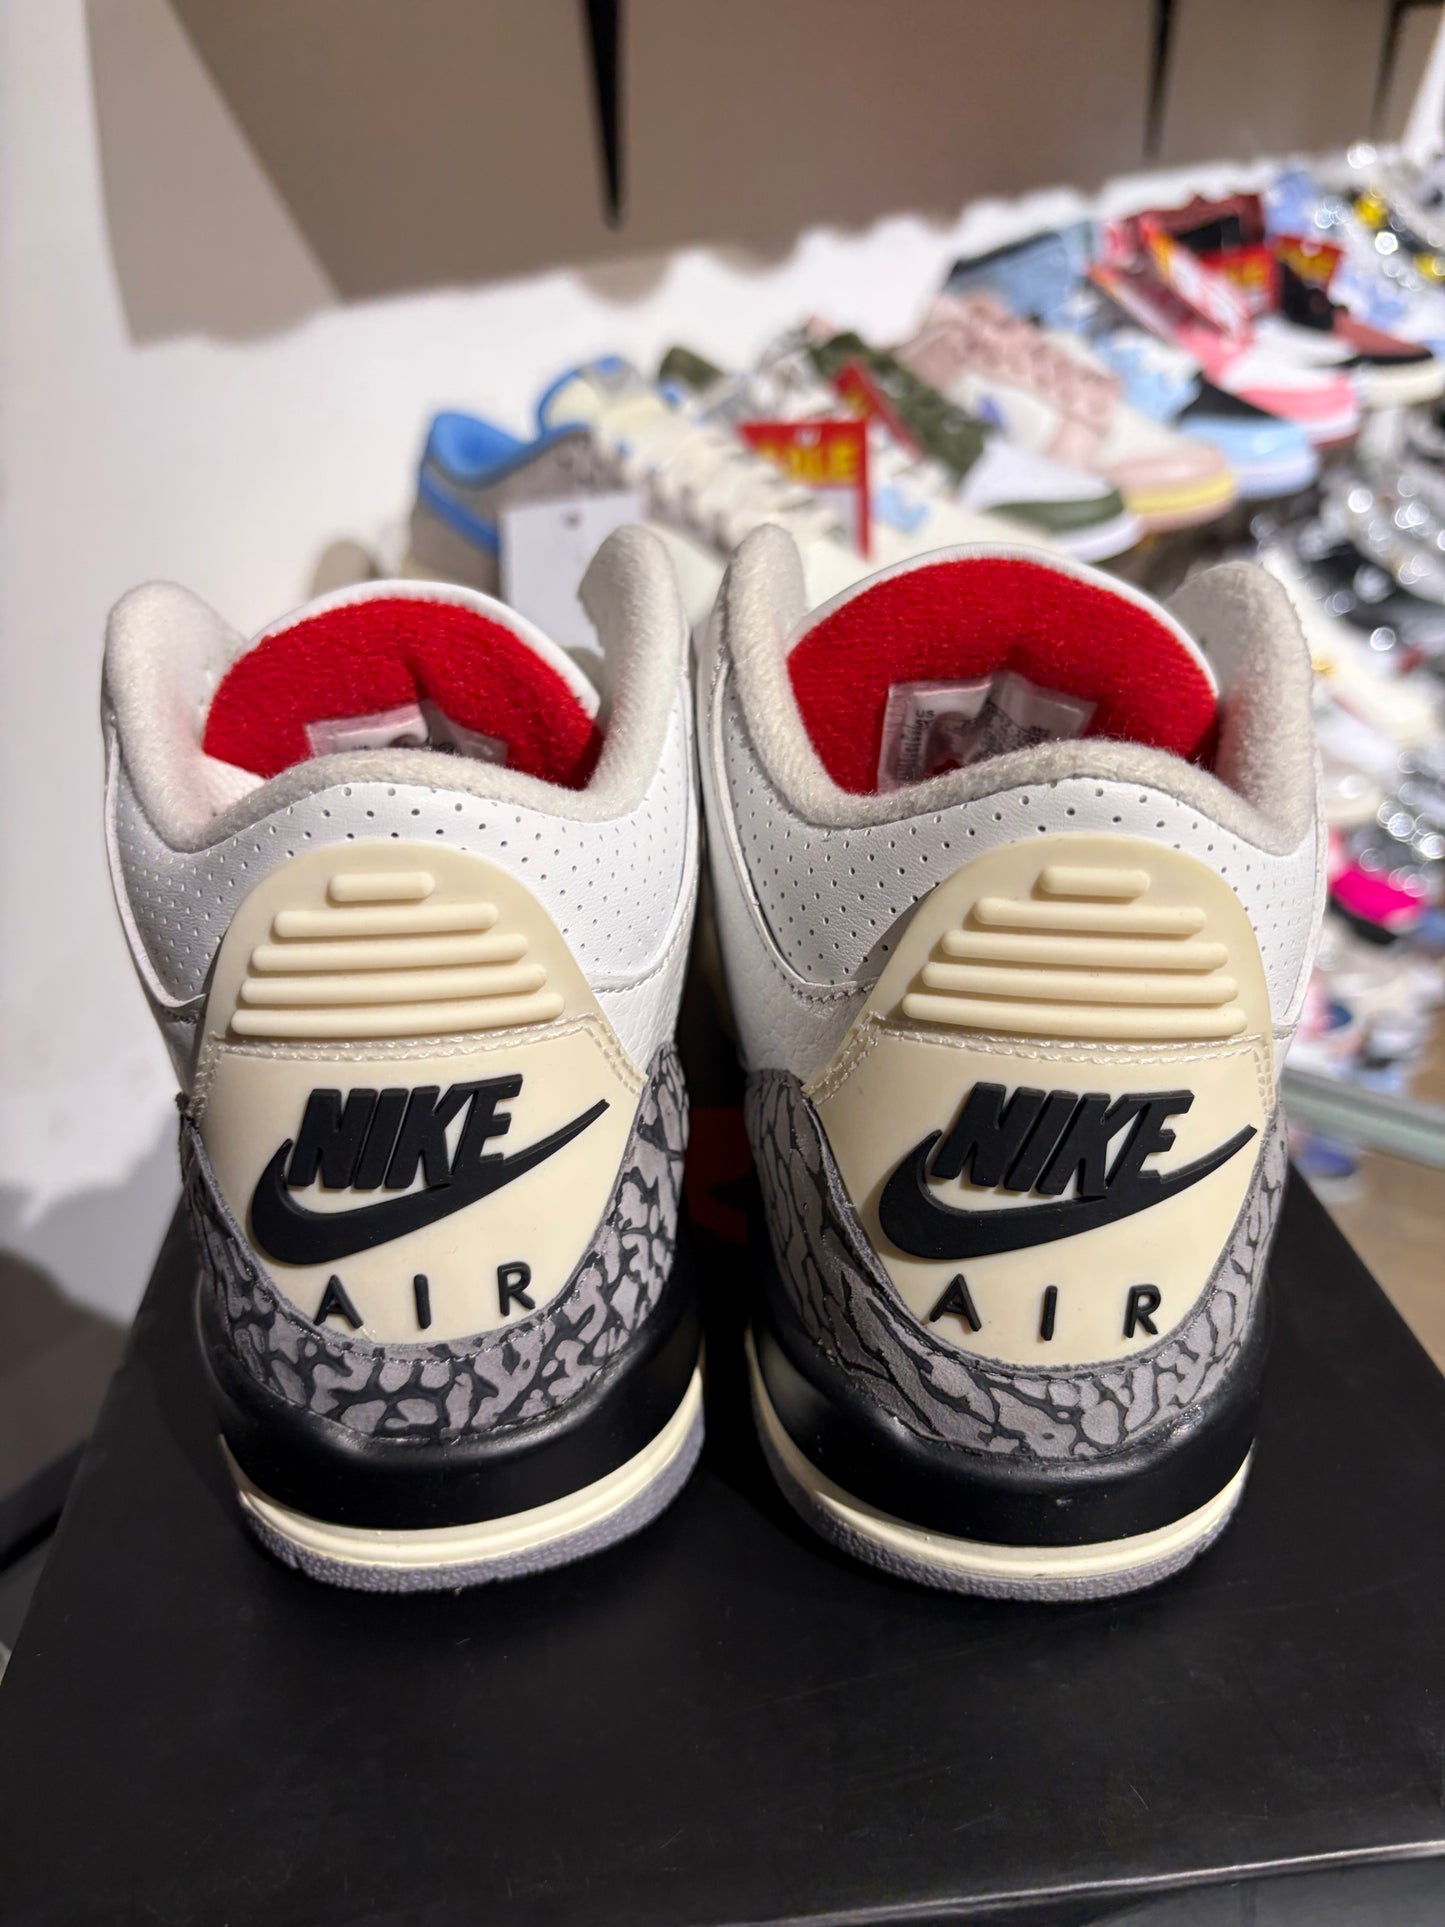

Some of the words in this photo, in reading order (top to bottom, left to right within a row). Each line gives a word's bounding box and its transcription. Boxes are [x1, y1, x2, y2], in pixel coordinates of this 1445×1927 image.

[287, 1073, 523, 1190] NIKE
[930, 1081, 1195, 1197] NIKE
[313, 1261, 536, 1330] AIR
[929, 1273, 1162, 1342] AIR
